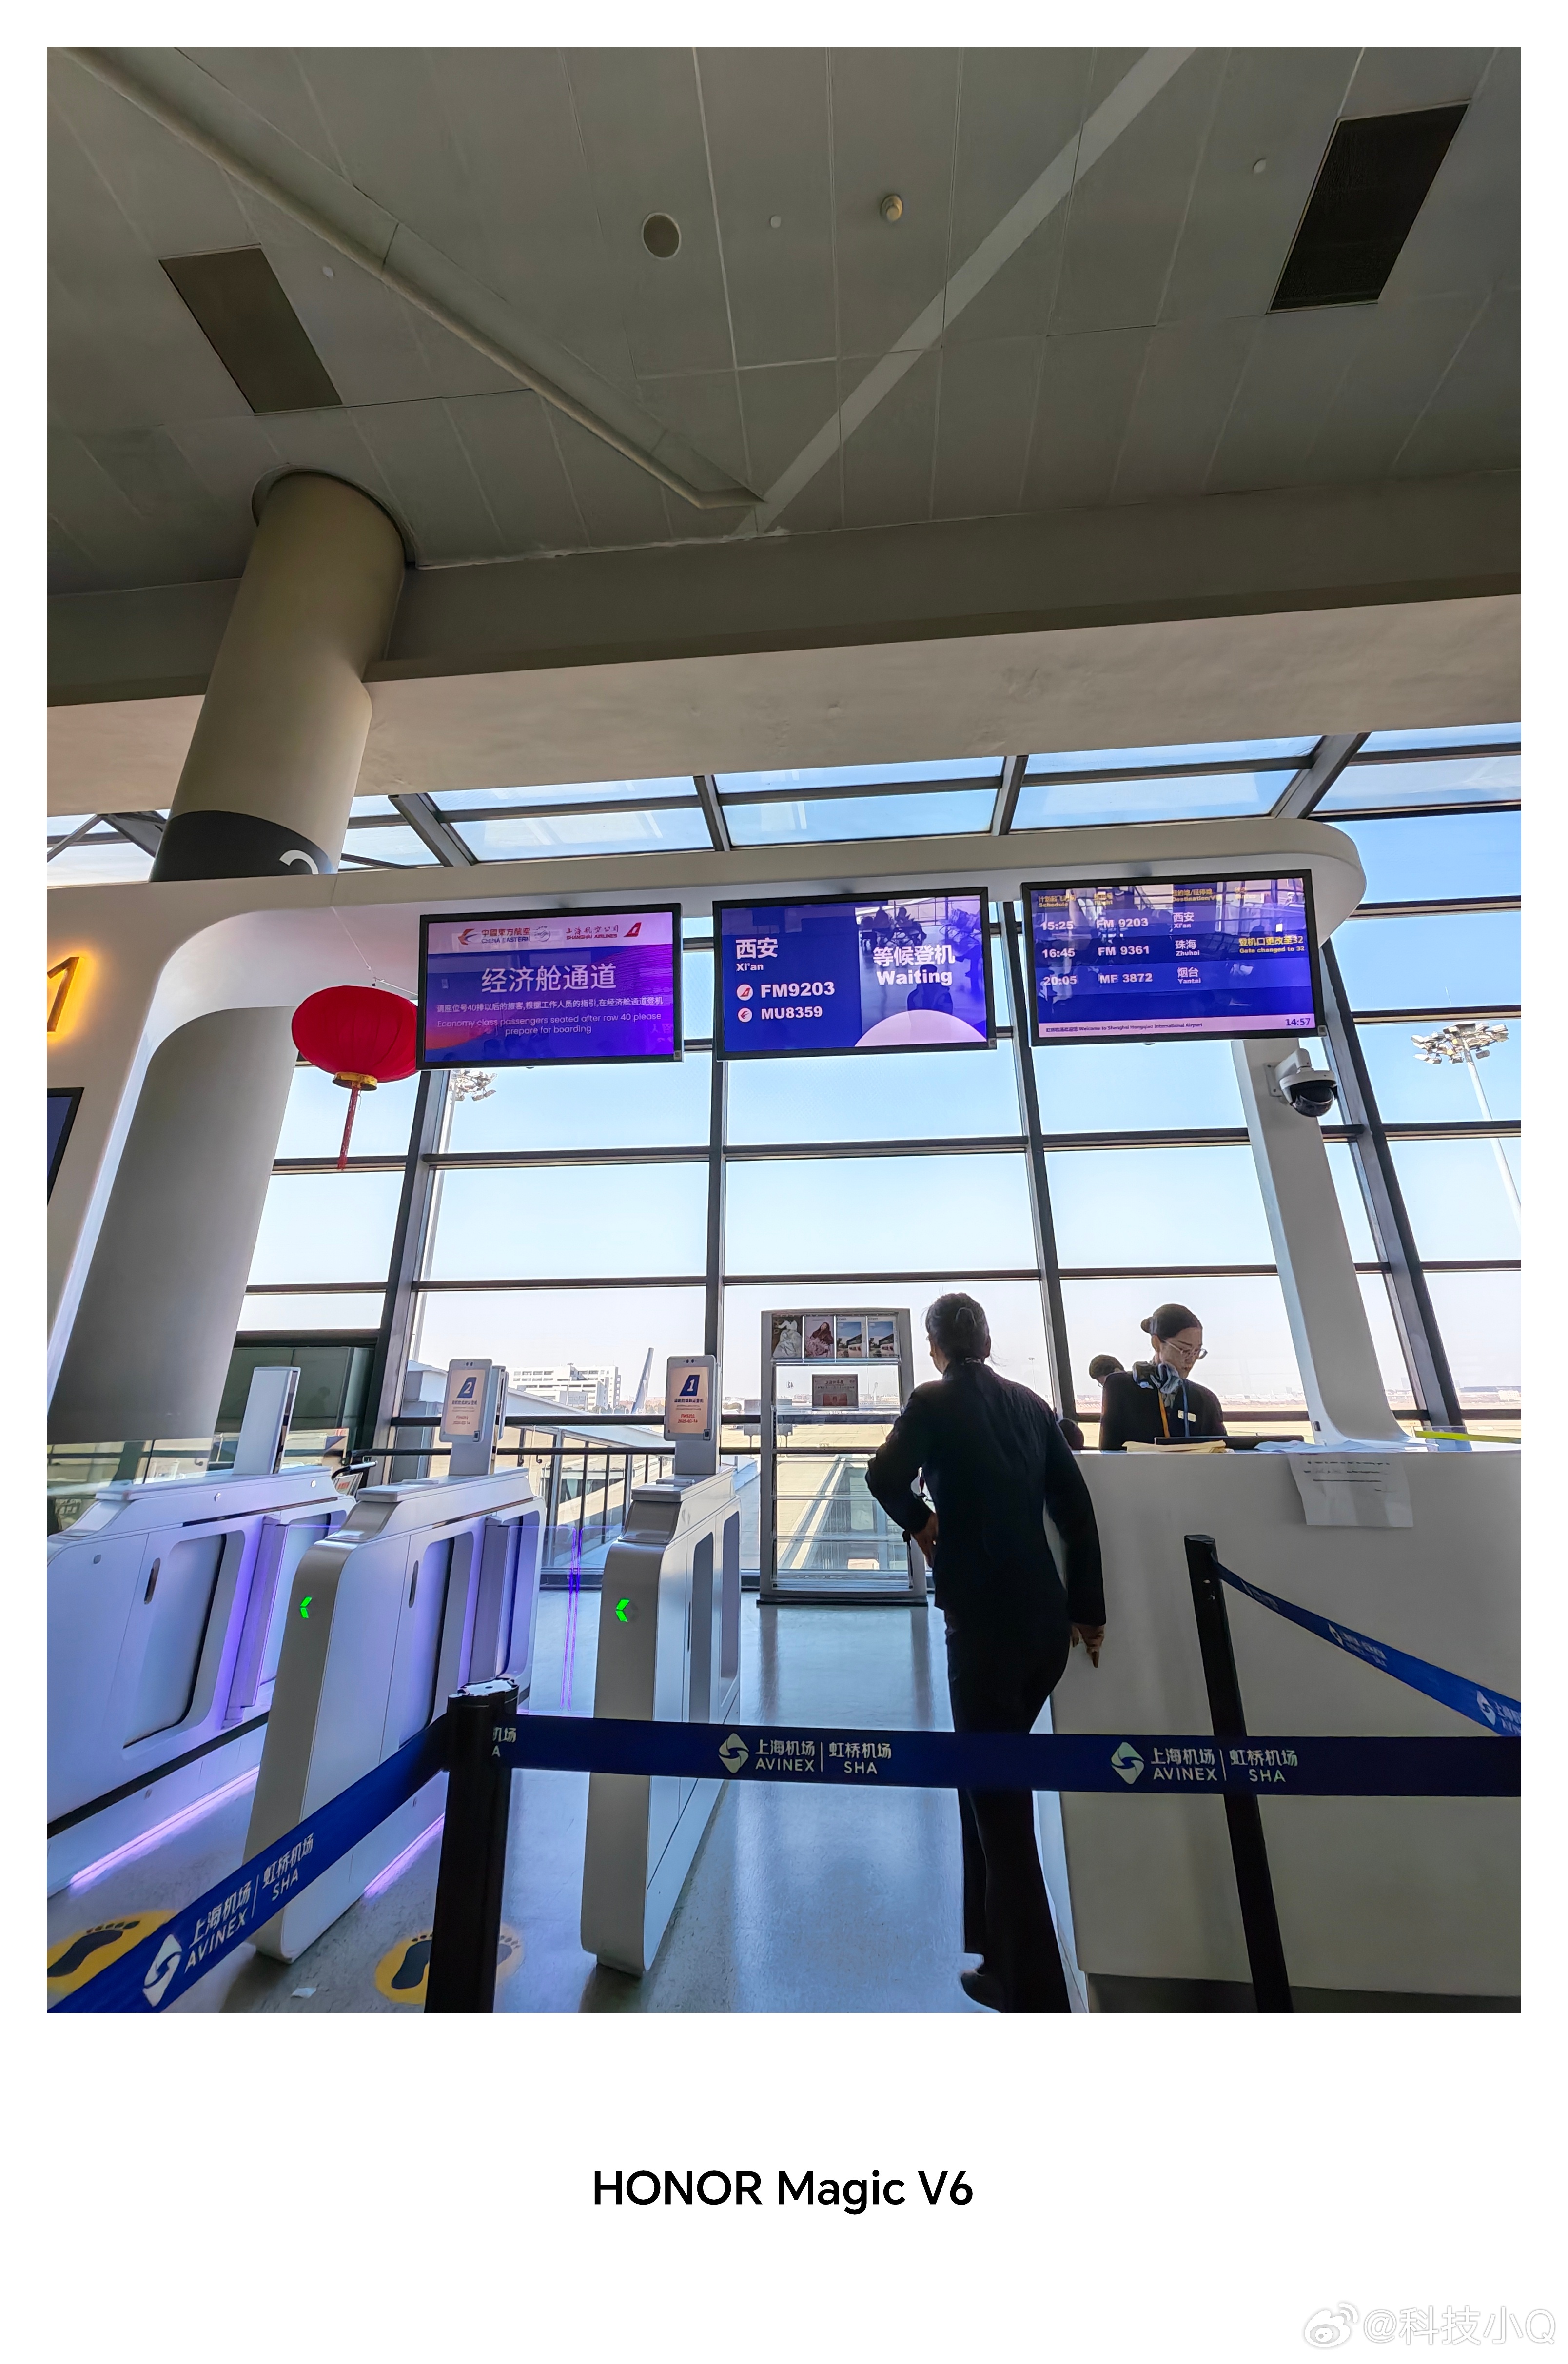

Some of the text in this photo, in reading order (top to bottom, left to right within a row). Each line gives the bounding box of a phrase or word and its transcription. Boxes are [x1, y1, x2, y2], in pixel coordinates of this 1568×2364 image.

[1041, 918, 1149, 930] 15:25 FM 9203
[1173, 912, 1194, 923] 西安
[736, 937, 779, 959] 西安
[1042, 945, 1150, 958] 16:45 FM 9361
[1175, 939, 1197, 950] 珠海
[873, 945, 955, 967] 等候登机
[736, 962, 764, 972] Xi'an
[1177, 967, 1199, 978] 烟台
[481, 962, 617, 993] 经济舱通道
[876, 969, 953, 986] Waiting
[1043, 975, 1077, 986] 20:05
[1123, 973, 1153, 983] 3872
[761, 982, 835, 998] FM9203
[761, 1006, 823, 1020] MU8359
[437, 1020, 475, 1028] Economy
[500, 1017, 548, 1027] passengers
[634, 1013, 662, 1022] please
[1285, 1017, 1311, 1026] 14:57
[505, 1027, 538, 1037] prepare
[553, 1025, 592, 1034] boarding
[464, 1381, 472, 1394] 2
[687, 1379, 695, 1392] 1
[755, 1739, 892, 1759] 上海机场 虹桥机场
[1151, 1747, 1298, 1767] 上海机场 虹桥机场
[755, 1757, 878, 1774] AVINEX SHA
[1153, 1767, 1286, 1783] AVINEX SHA
[188, 1832, 314, 1950] 上海机场 虹桥机场
[184, 1868, 298, 1974] AVINEX SHA
